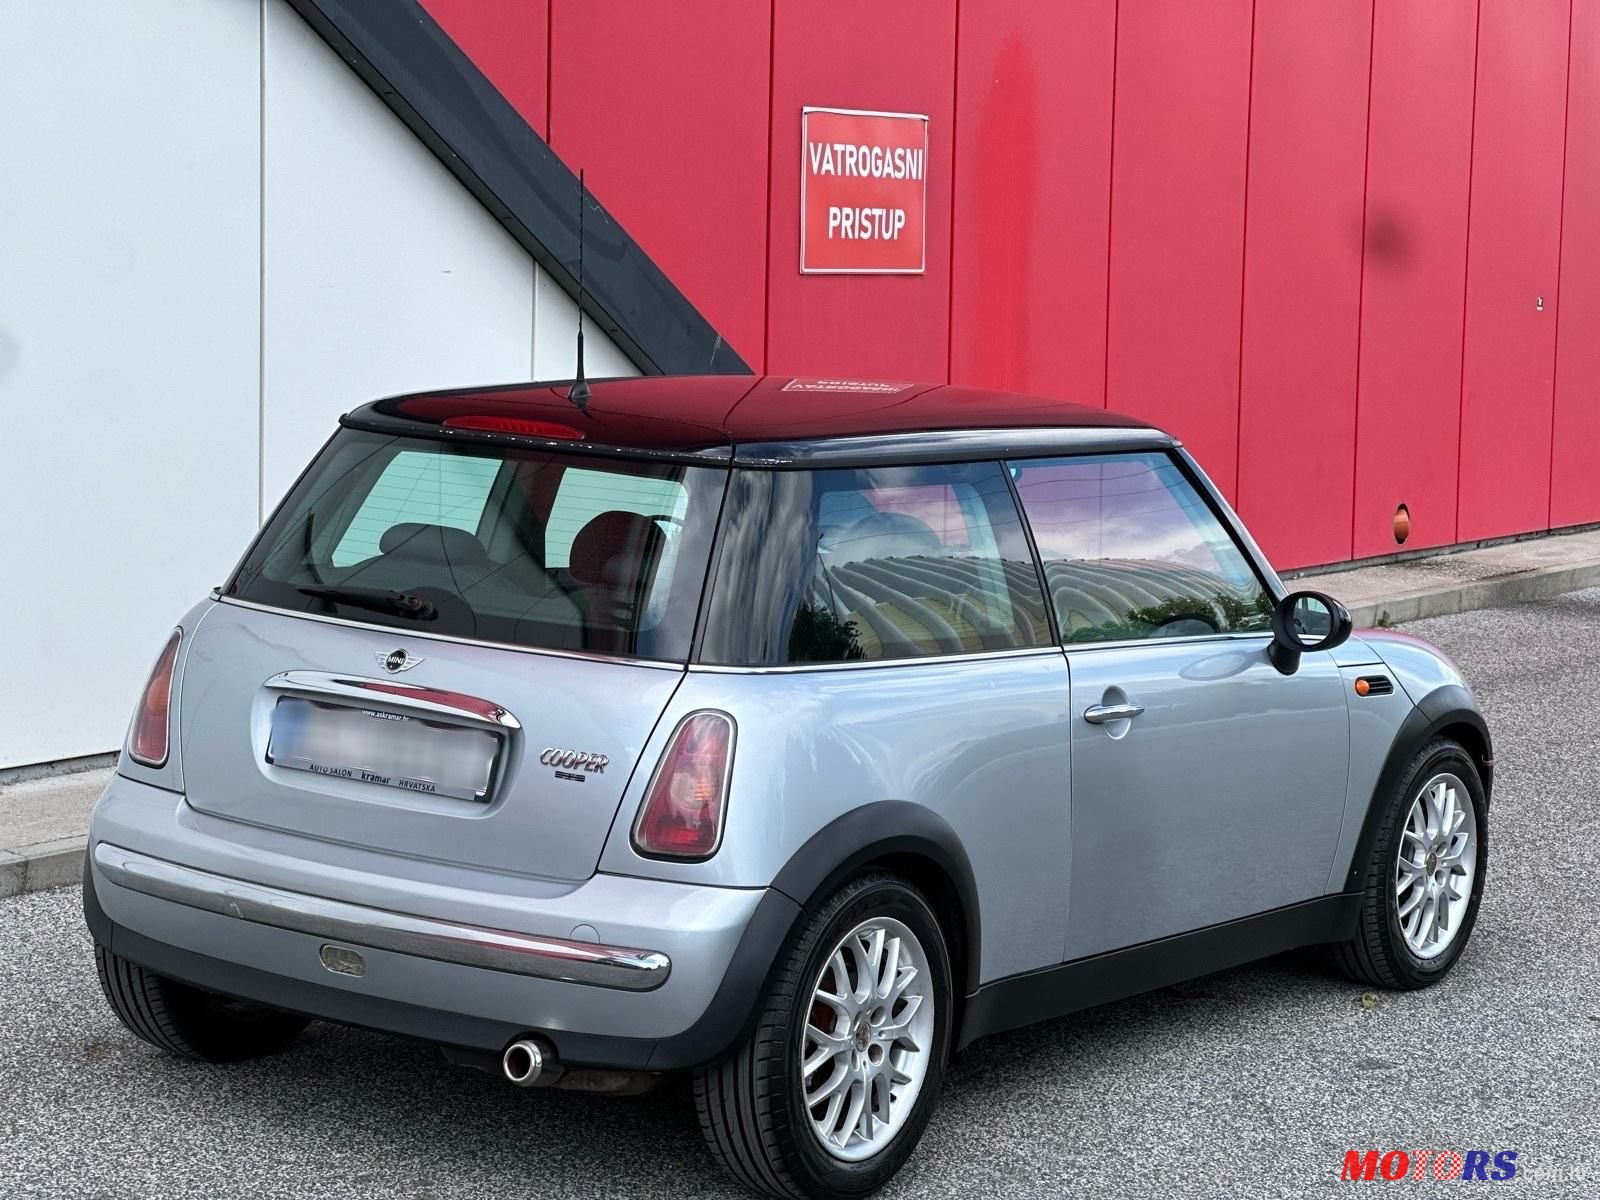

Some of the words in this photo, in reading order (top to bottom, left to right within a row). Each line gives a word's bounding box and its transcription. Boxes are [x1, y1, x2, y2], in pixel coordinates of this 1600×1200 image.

[809, 142, 923, 180] VATROGASNI
[828, 207, 906, 240] PRISTUP
[387, 656, 405, 664] MINI
[540, 747, 609, 774] COOPER
[309, 763, 328, 773] AUTO
[329, 767, 353, 777] SALON
[361, 770, 391, 784] kramar
[398, 779, 436, 793] HRVATSKA
